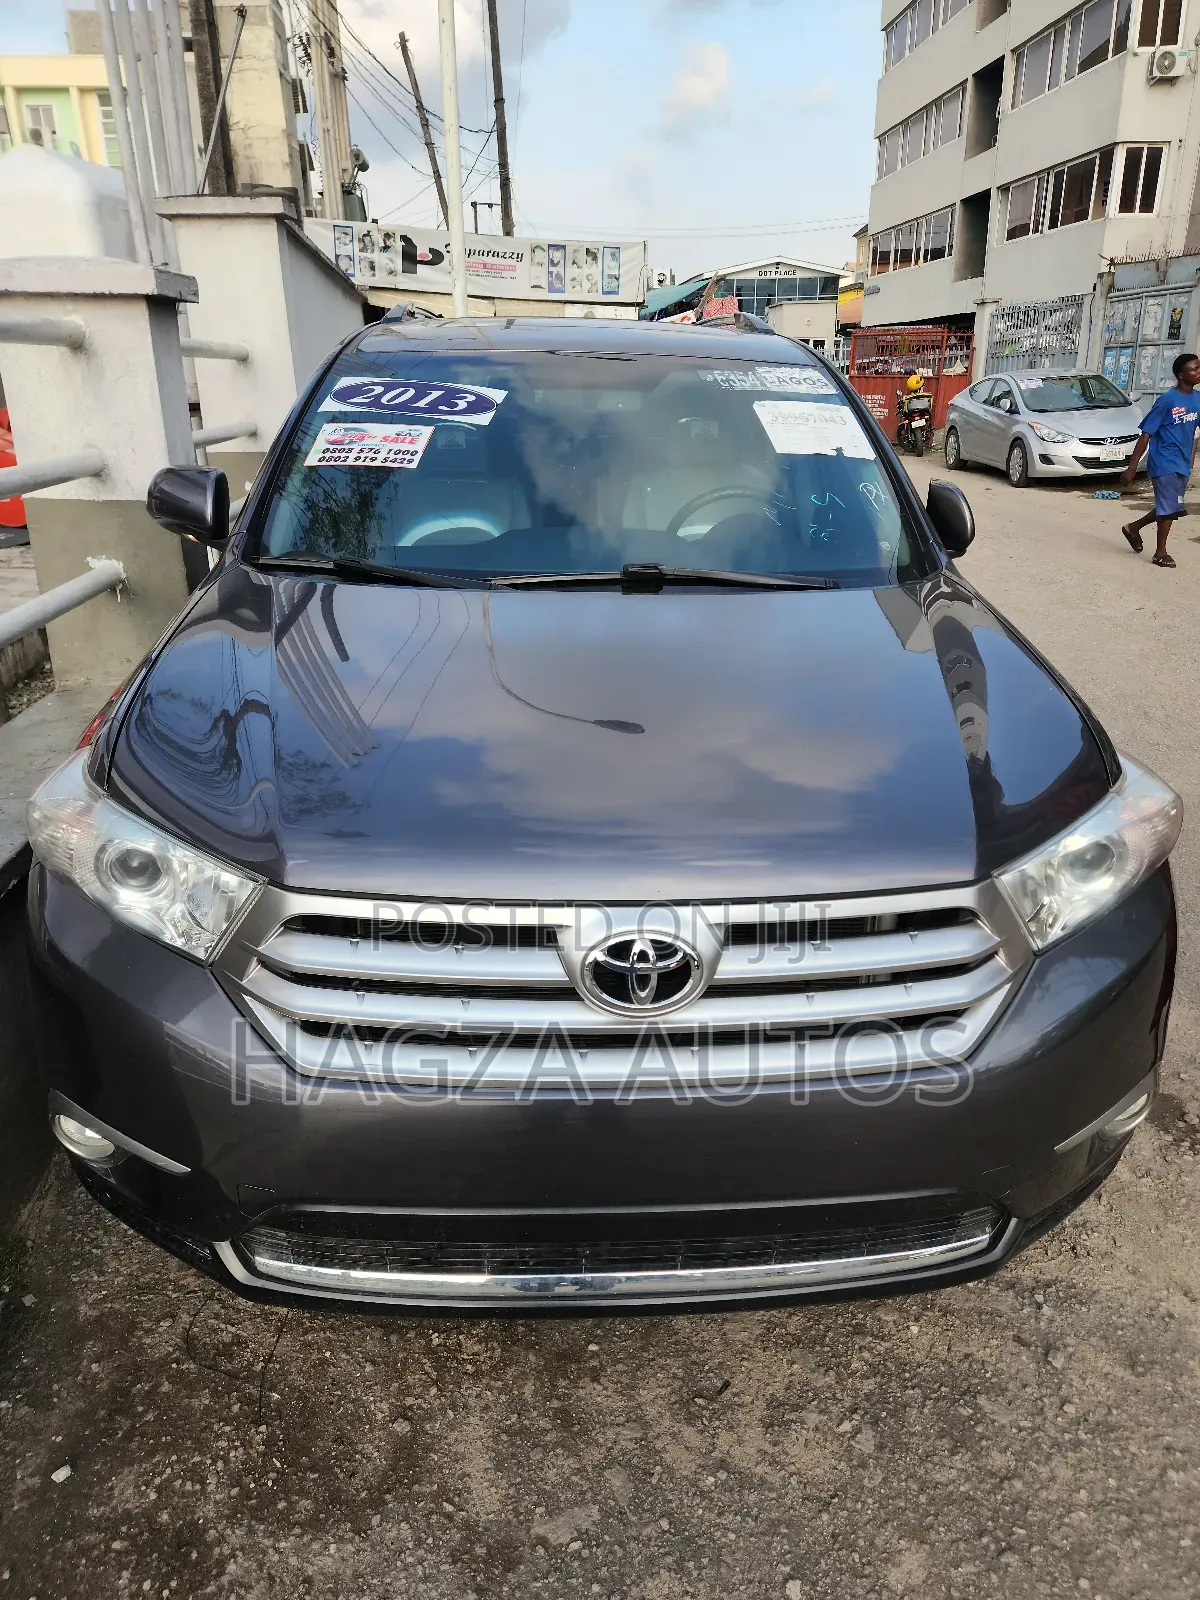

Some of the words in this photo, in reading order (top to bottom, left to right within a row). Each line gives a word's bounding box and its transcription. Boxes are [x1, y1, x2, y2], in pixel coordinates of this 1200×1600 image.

[445, 243, 524, 262] parazzy
[347, 385, 477, 412] 2013
[379, 435, 420, 445] SALE
[386, 449, 419, 457] 1000
